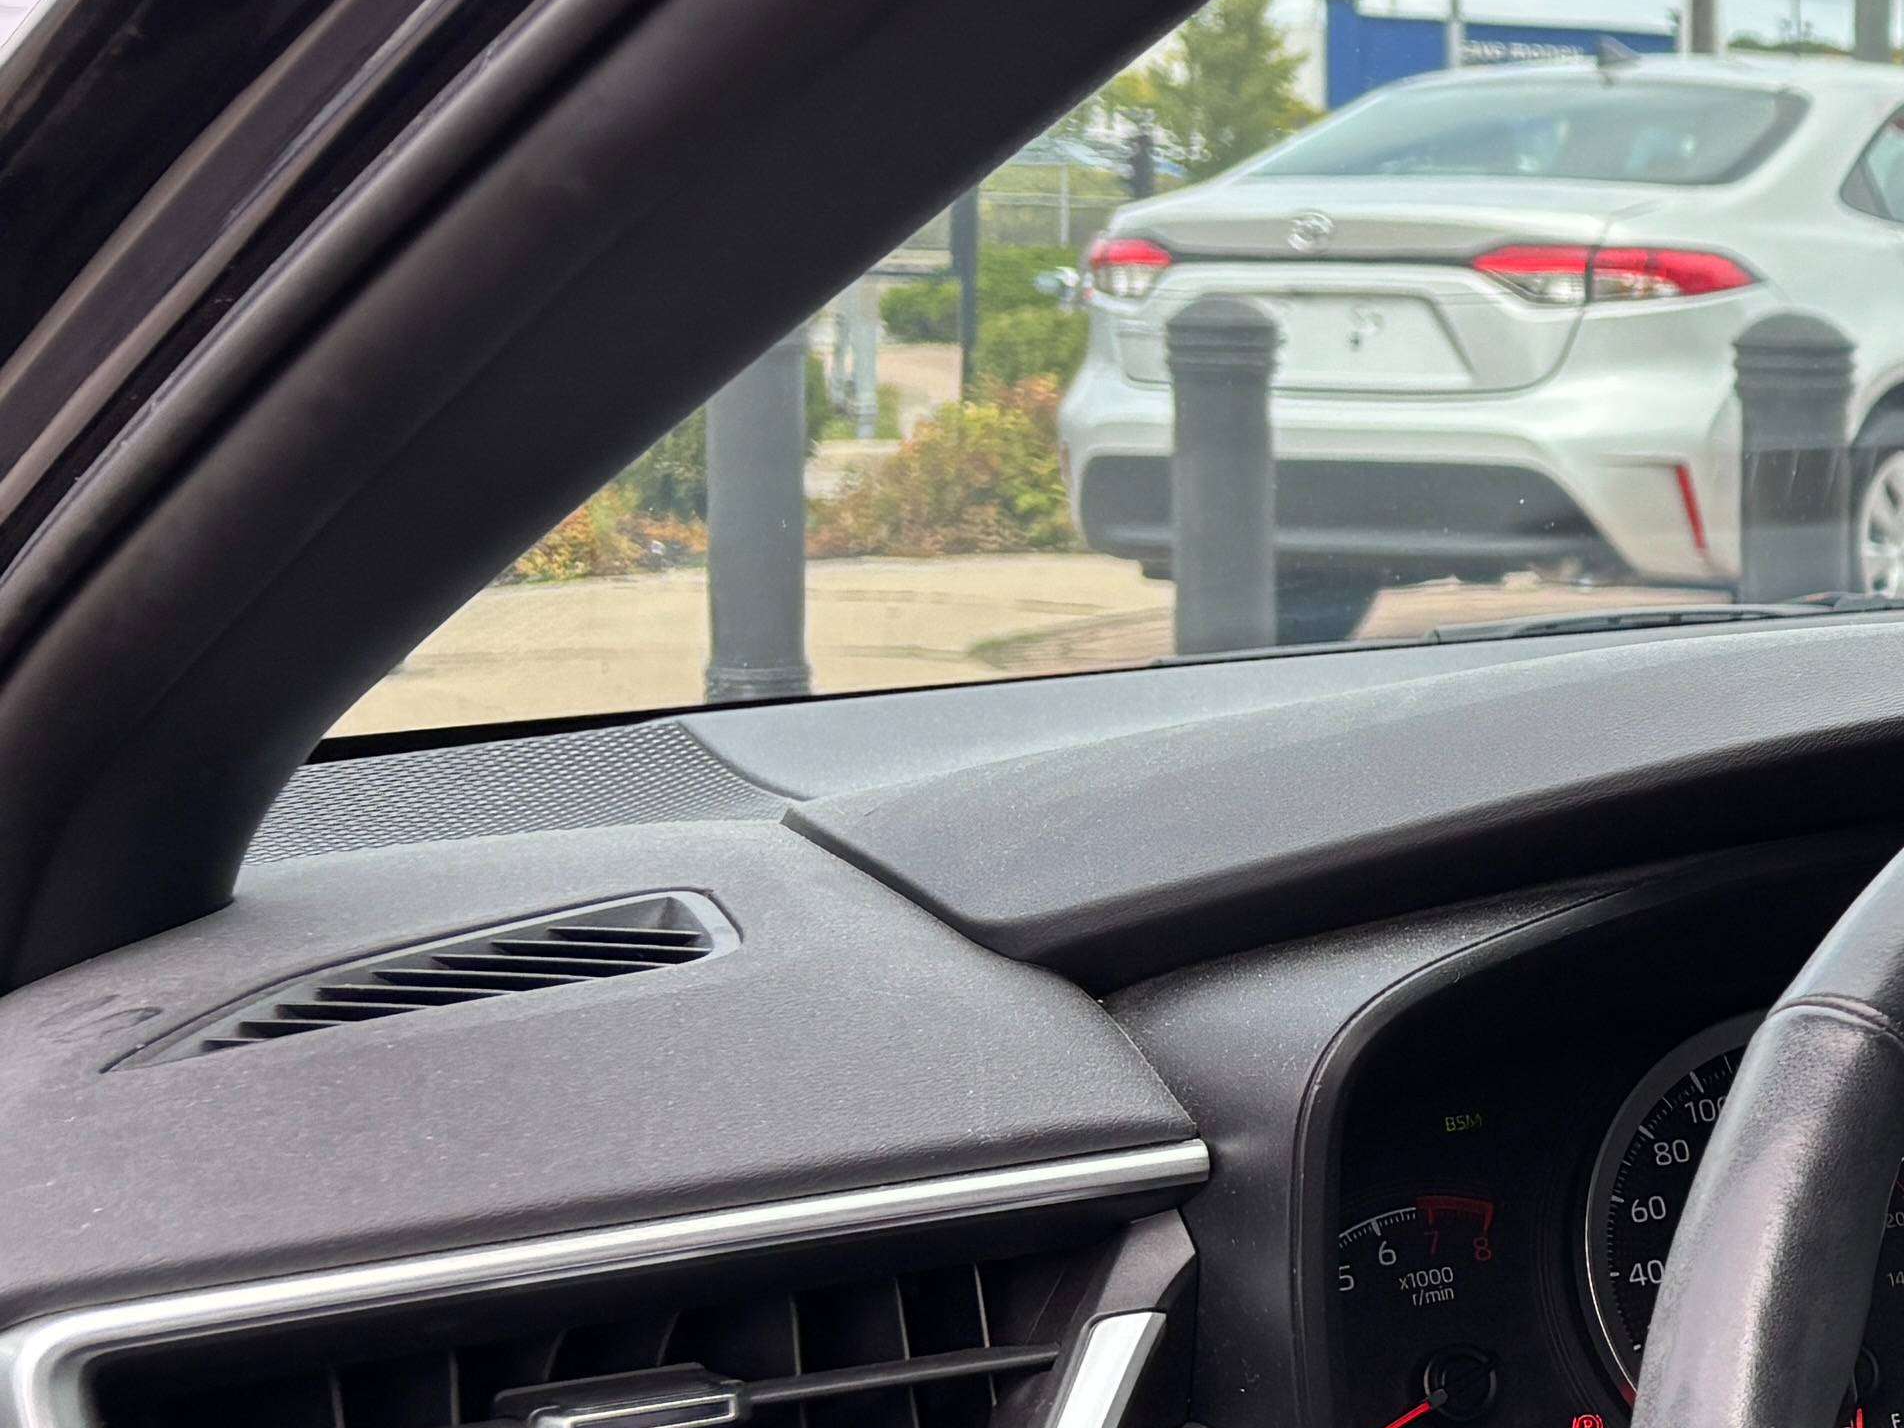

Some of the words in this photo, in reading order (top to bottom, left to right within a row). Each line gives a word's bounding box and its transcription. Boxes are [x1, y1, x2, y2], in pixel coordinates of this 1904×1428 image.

[1654, 1139, 1690, 1166] 80
[1631, 1195, 1667, 1223] 60
[1378, 1241, 1397, 1265] 6
[1424, 1230, 1439, 1254] 7
[1473, 1236, 1492, 1261] 8
[1338, 1265, 1355, 1291] 5
[1399, 1266, 1454, 1291] x1000
[1629, 1259, 1665, 1286] 40
[1412, 1286, 1455, 1306] r/min
